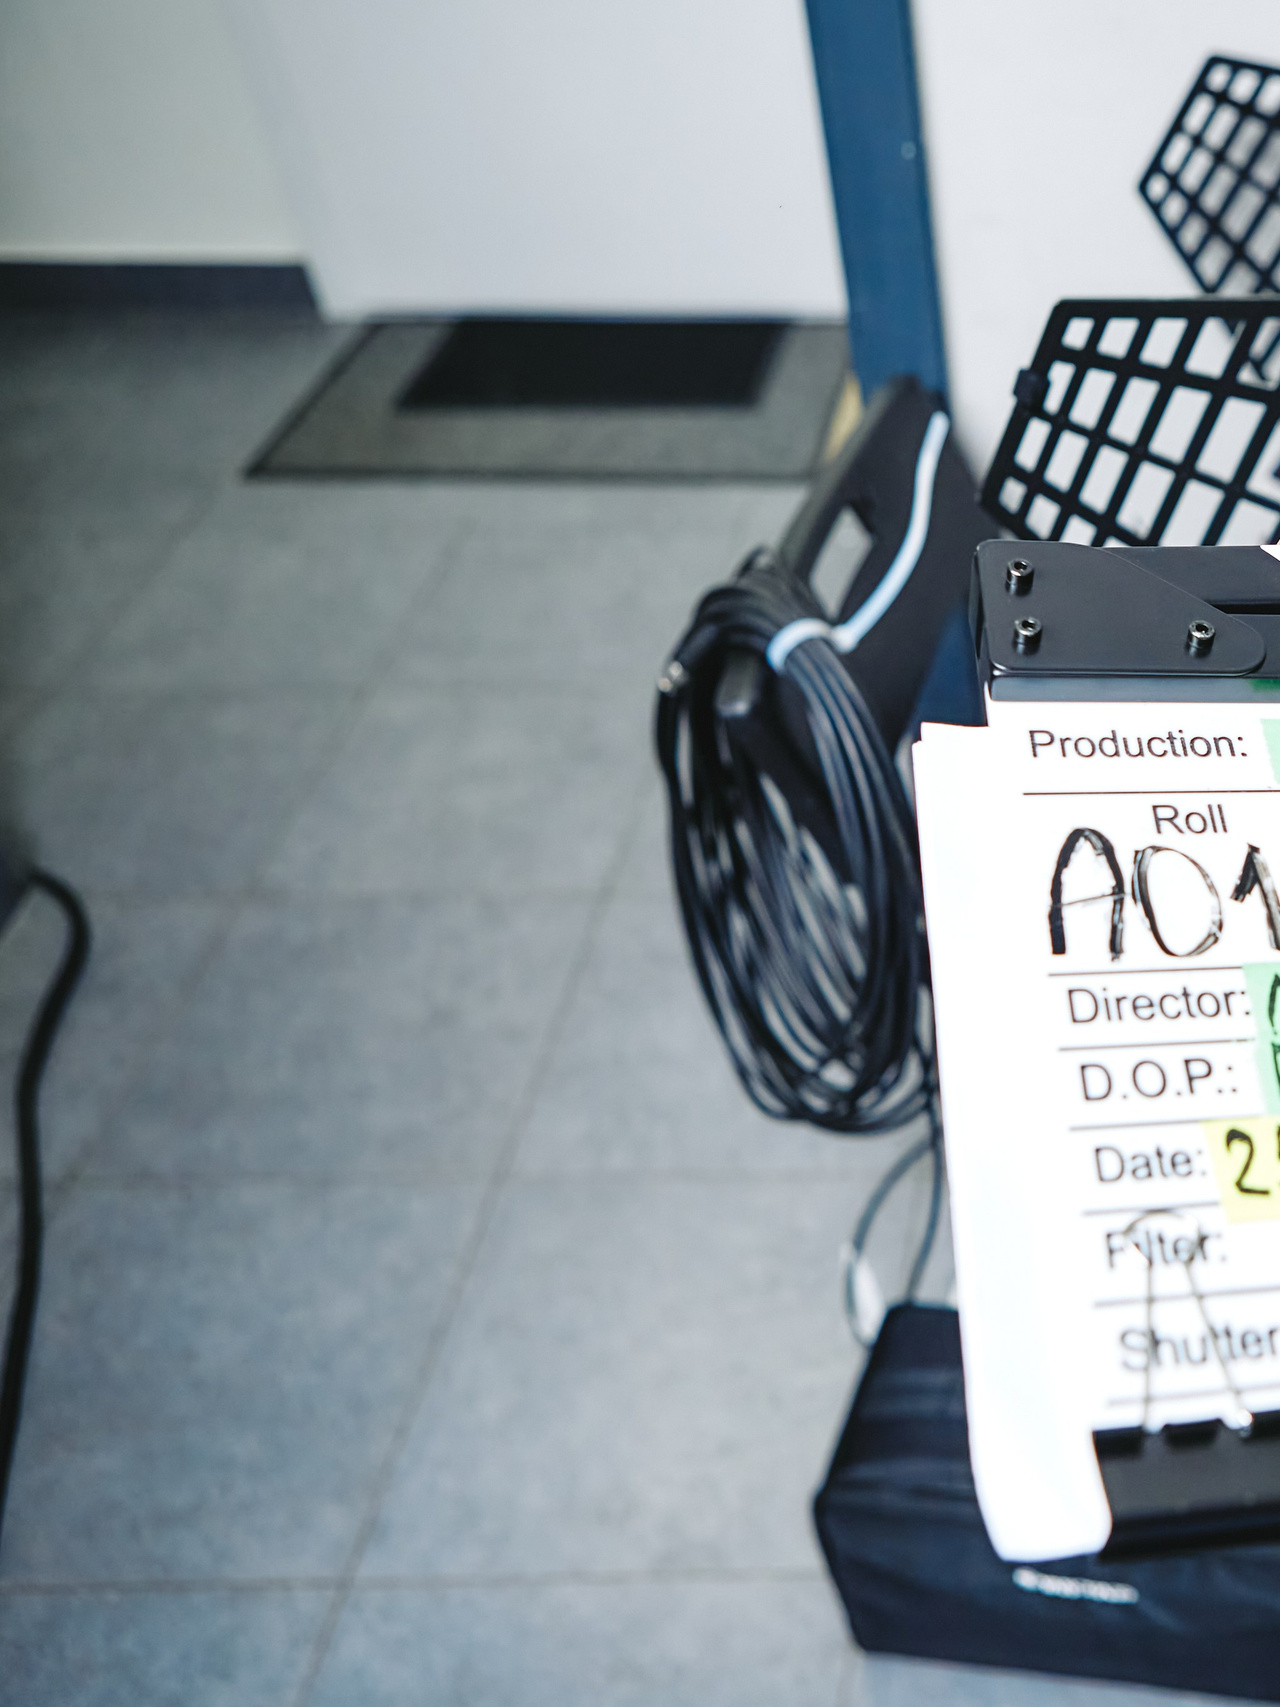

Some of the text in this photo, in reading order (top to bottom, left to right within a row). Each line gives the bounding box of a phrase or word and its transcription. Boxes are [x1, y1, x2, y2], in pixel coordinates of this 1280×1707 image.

[1028, 728, 1248, 760] Production:
[1152, 803, 1228, 834] Roll
[1066, 985, 1251, 1024] Director:
[1080, 1057, 1239, 1102] D.O.P.:
[1094, 1144, 1207, 1184] Date:
[1105, 1225, 1228, 1269] Filter:
